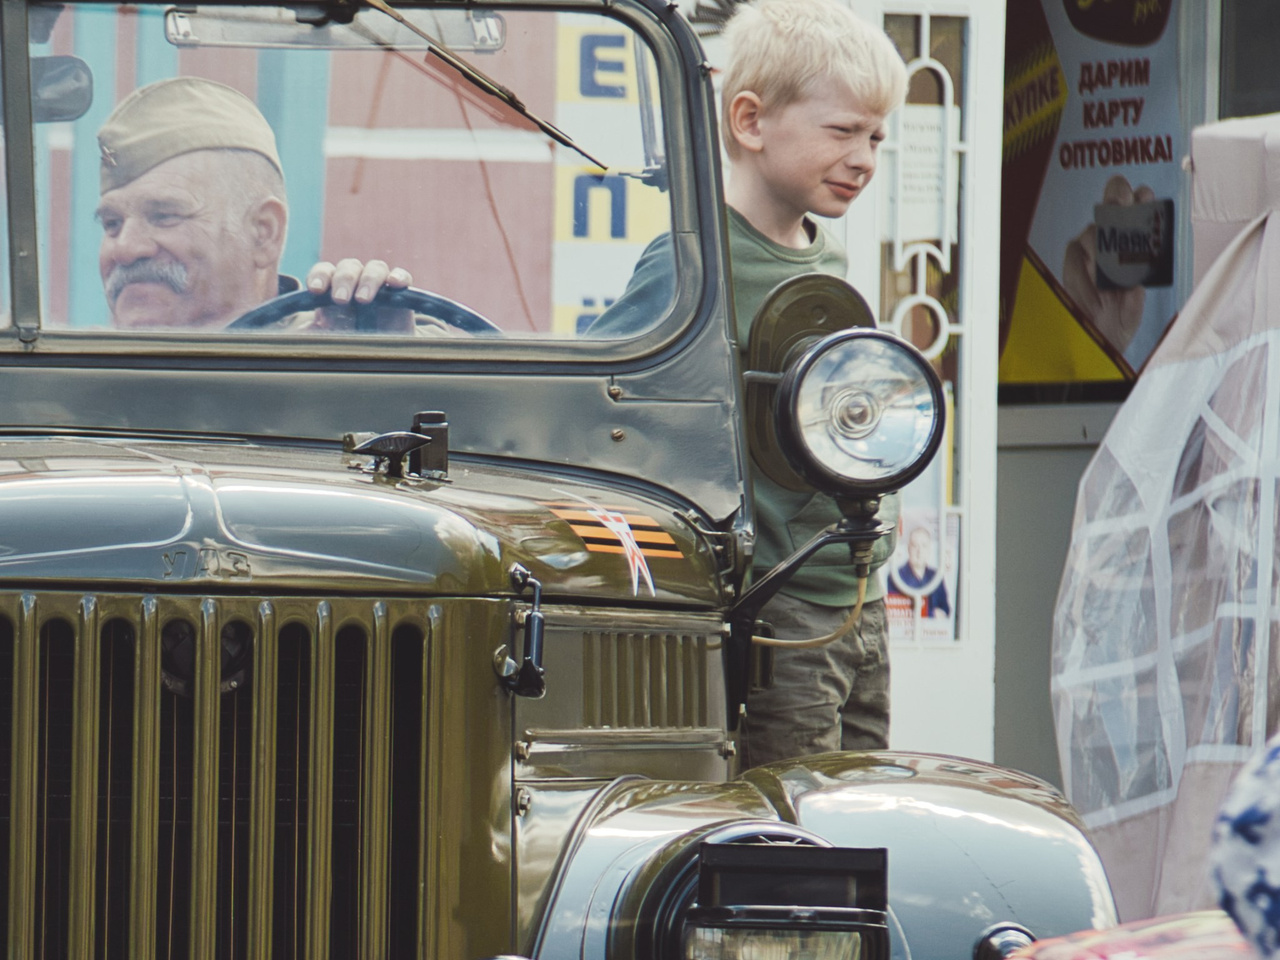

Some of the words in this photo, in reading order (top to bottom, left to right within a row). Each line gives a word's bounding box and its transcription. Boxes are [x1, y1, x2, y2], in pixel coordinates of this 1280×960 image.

[1079, 58, 1150, 95] ДАРИМ
[1083, 97, 1145, 129] КАРТУ
[1060, 134, 1173, 170] ОПТОВИКА!
